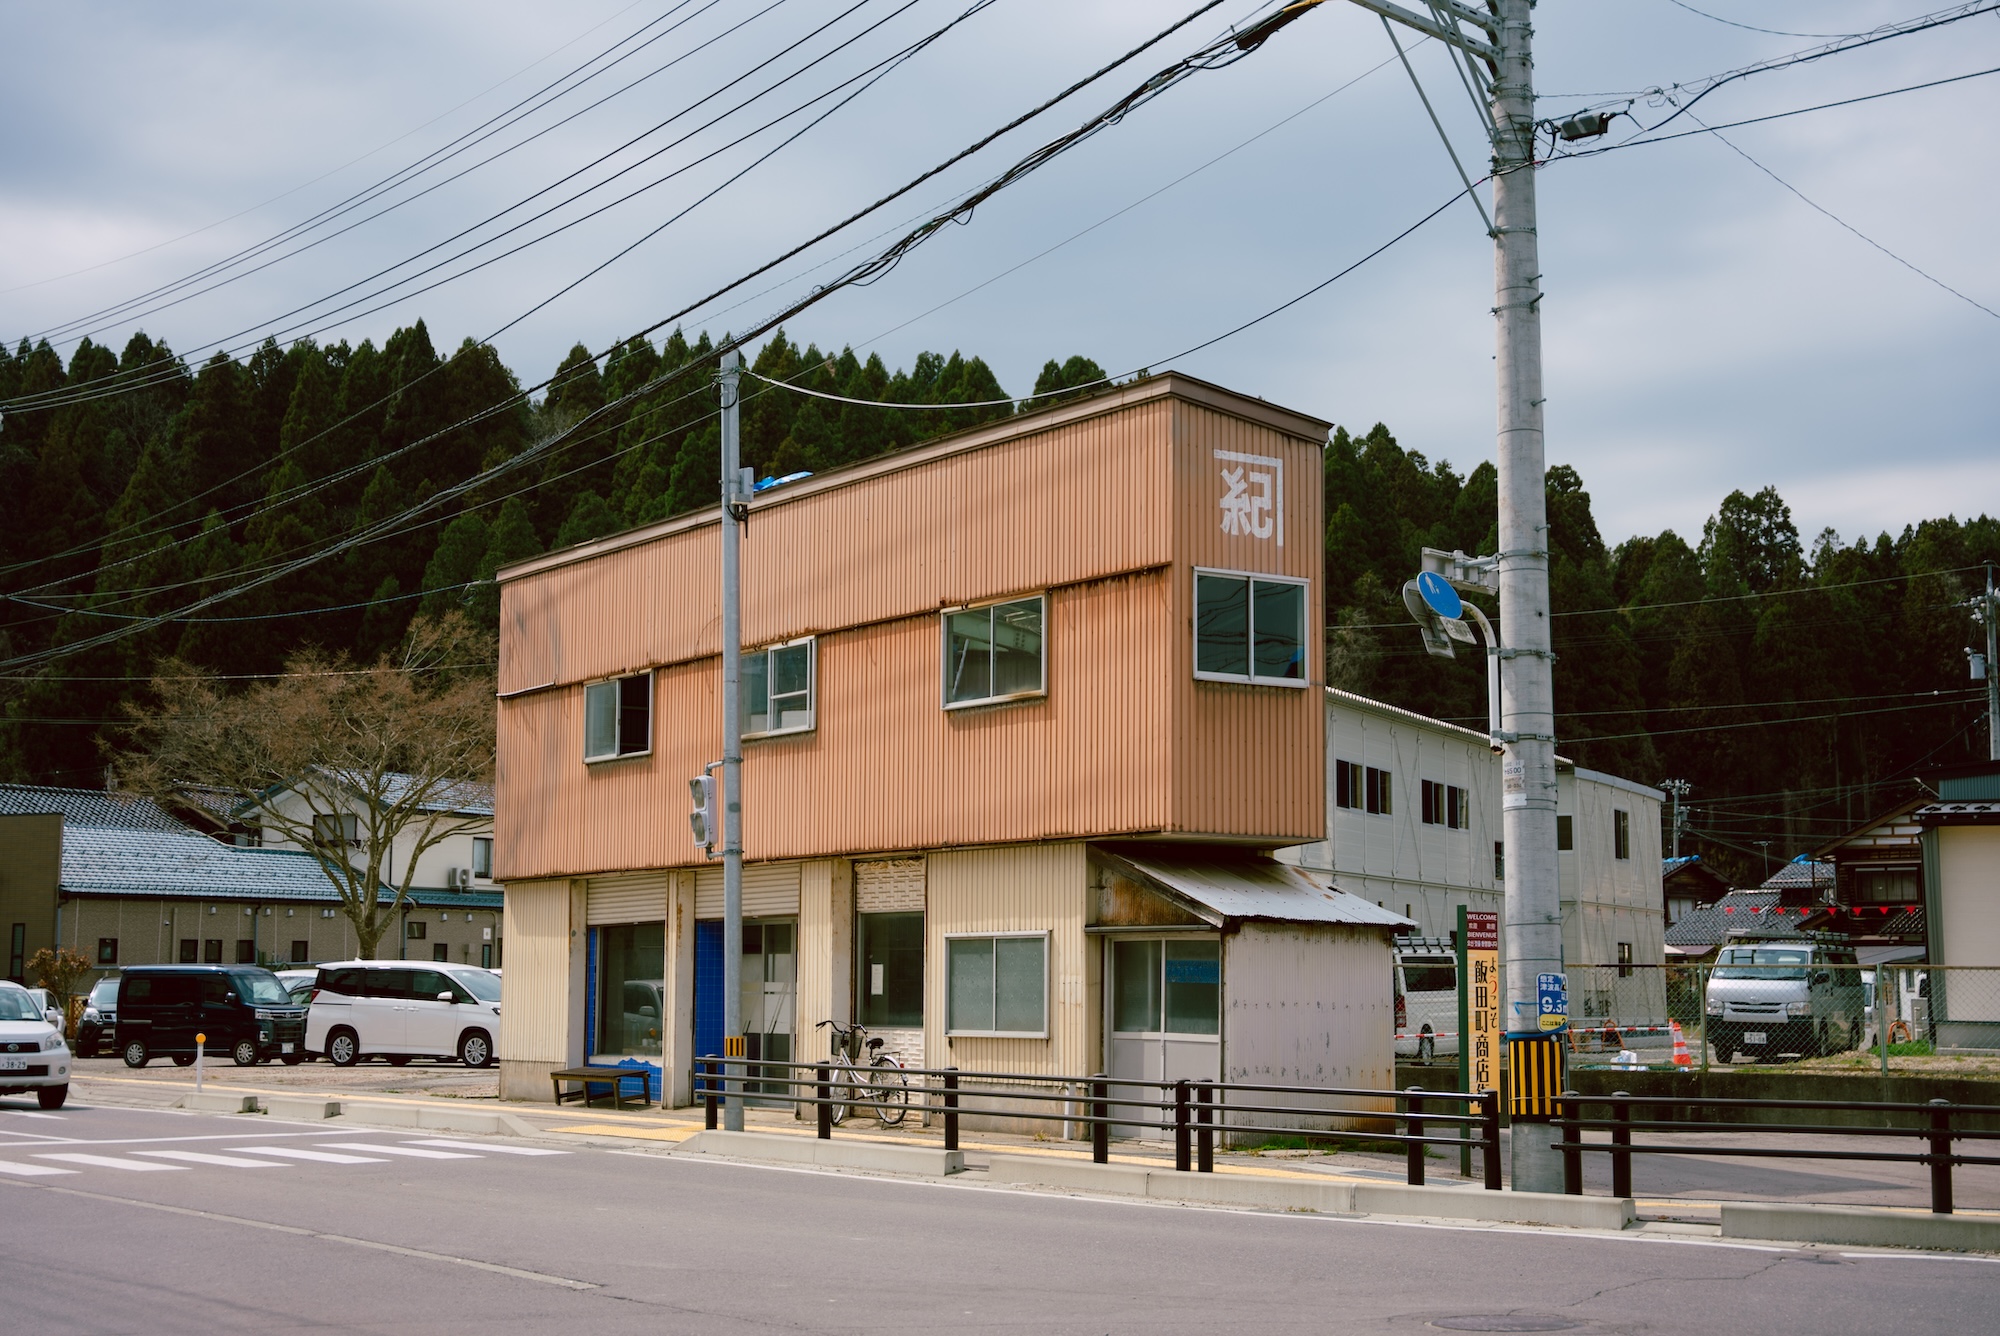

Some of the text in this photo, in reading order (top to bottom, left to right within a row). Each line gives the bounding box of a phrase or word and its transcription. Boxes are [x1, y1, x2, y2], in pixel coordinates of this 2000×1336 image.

[1219, 465, 1274, 539] 紀
[1467, 913, 1497, 921] WELCOME
[5, 1061, 26, 1069] 38-29
